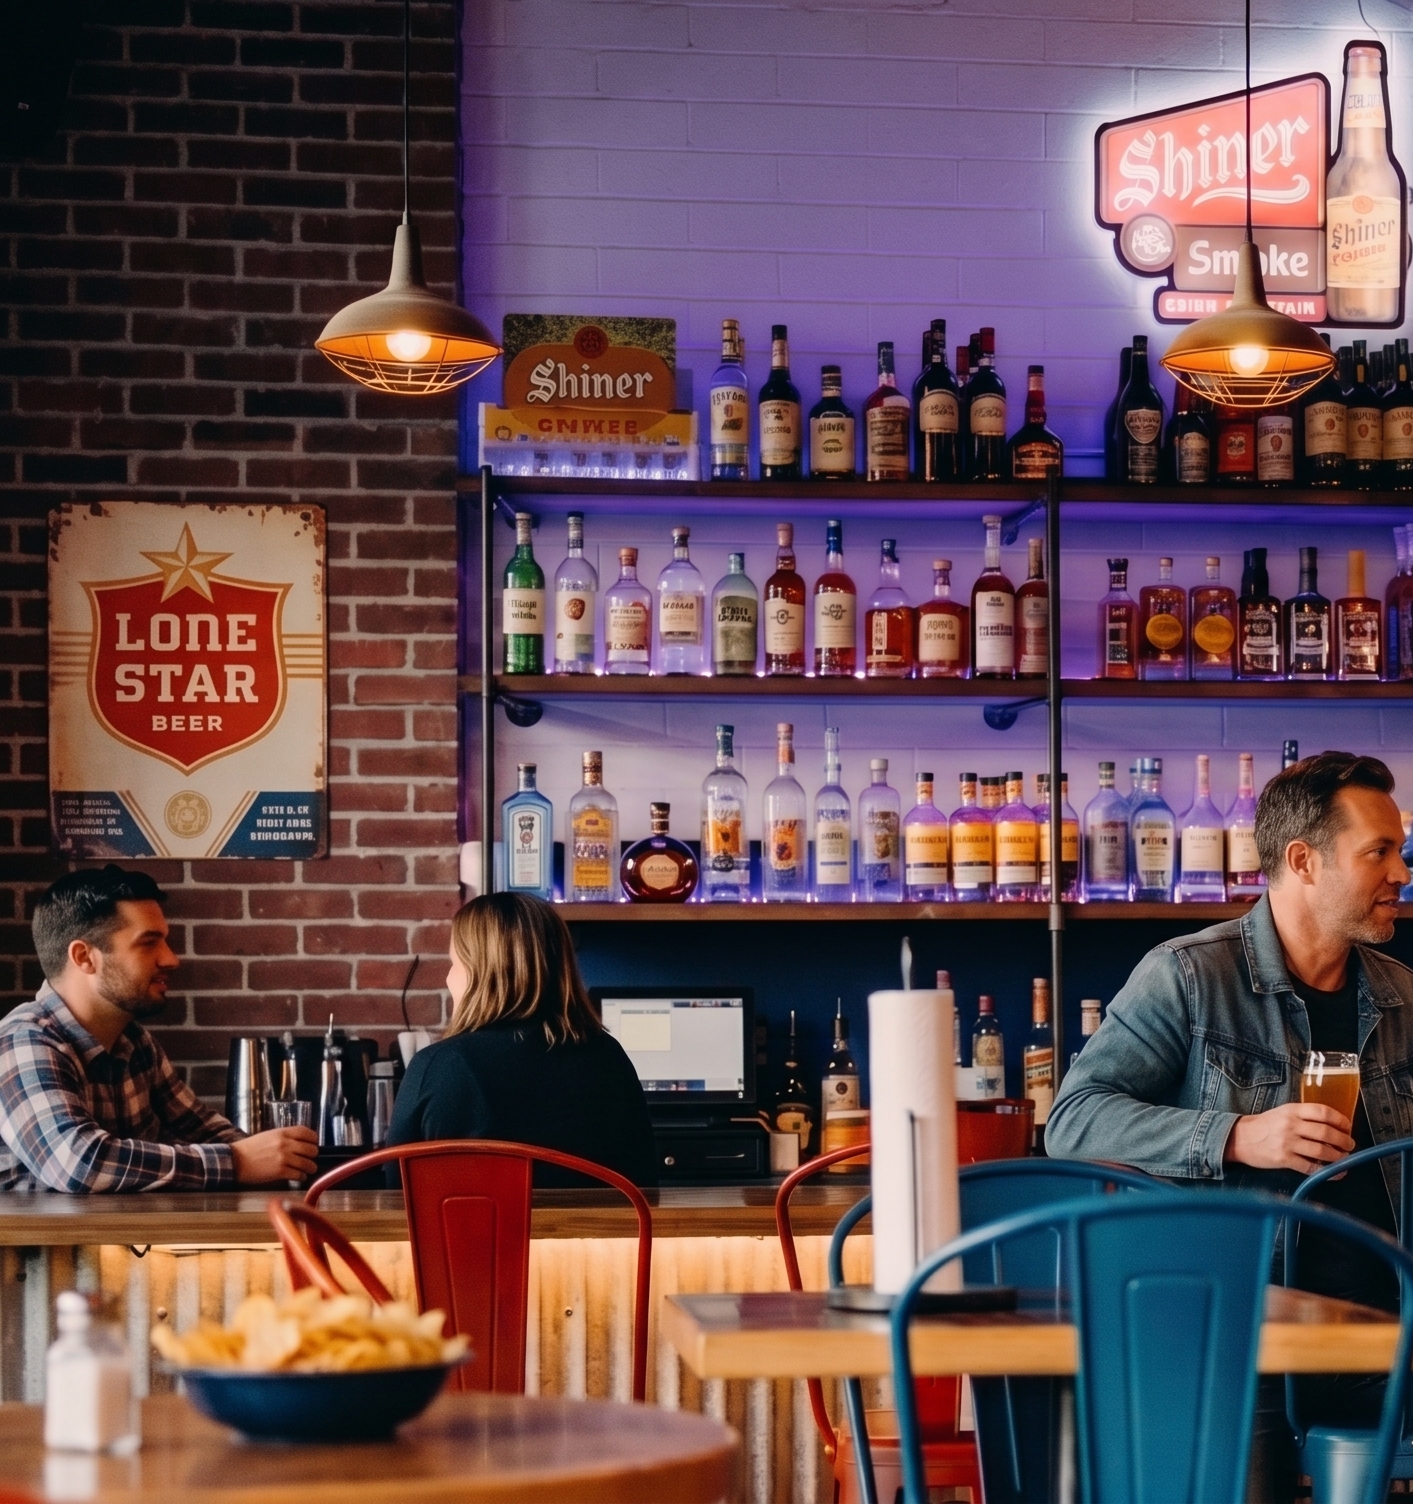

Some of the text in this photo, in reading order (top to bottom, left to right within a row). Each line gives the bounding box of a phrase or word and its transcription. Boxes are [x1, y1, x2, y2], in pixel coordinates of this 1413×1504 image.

[1113, 115, 1311, 212] Shiner
[1331, 218, 1395, 250] Shiner
[526, 358, 653, 403] Shiner
[115, 613, 257, 651] LONE
[114, 664, 259, 702] STAR
[151, 715, 223, 731] BEER
